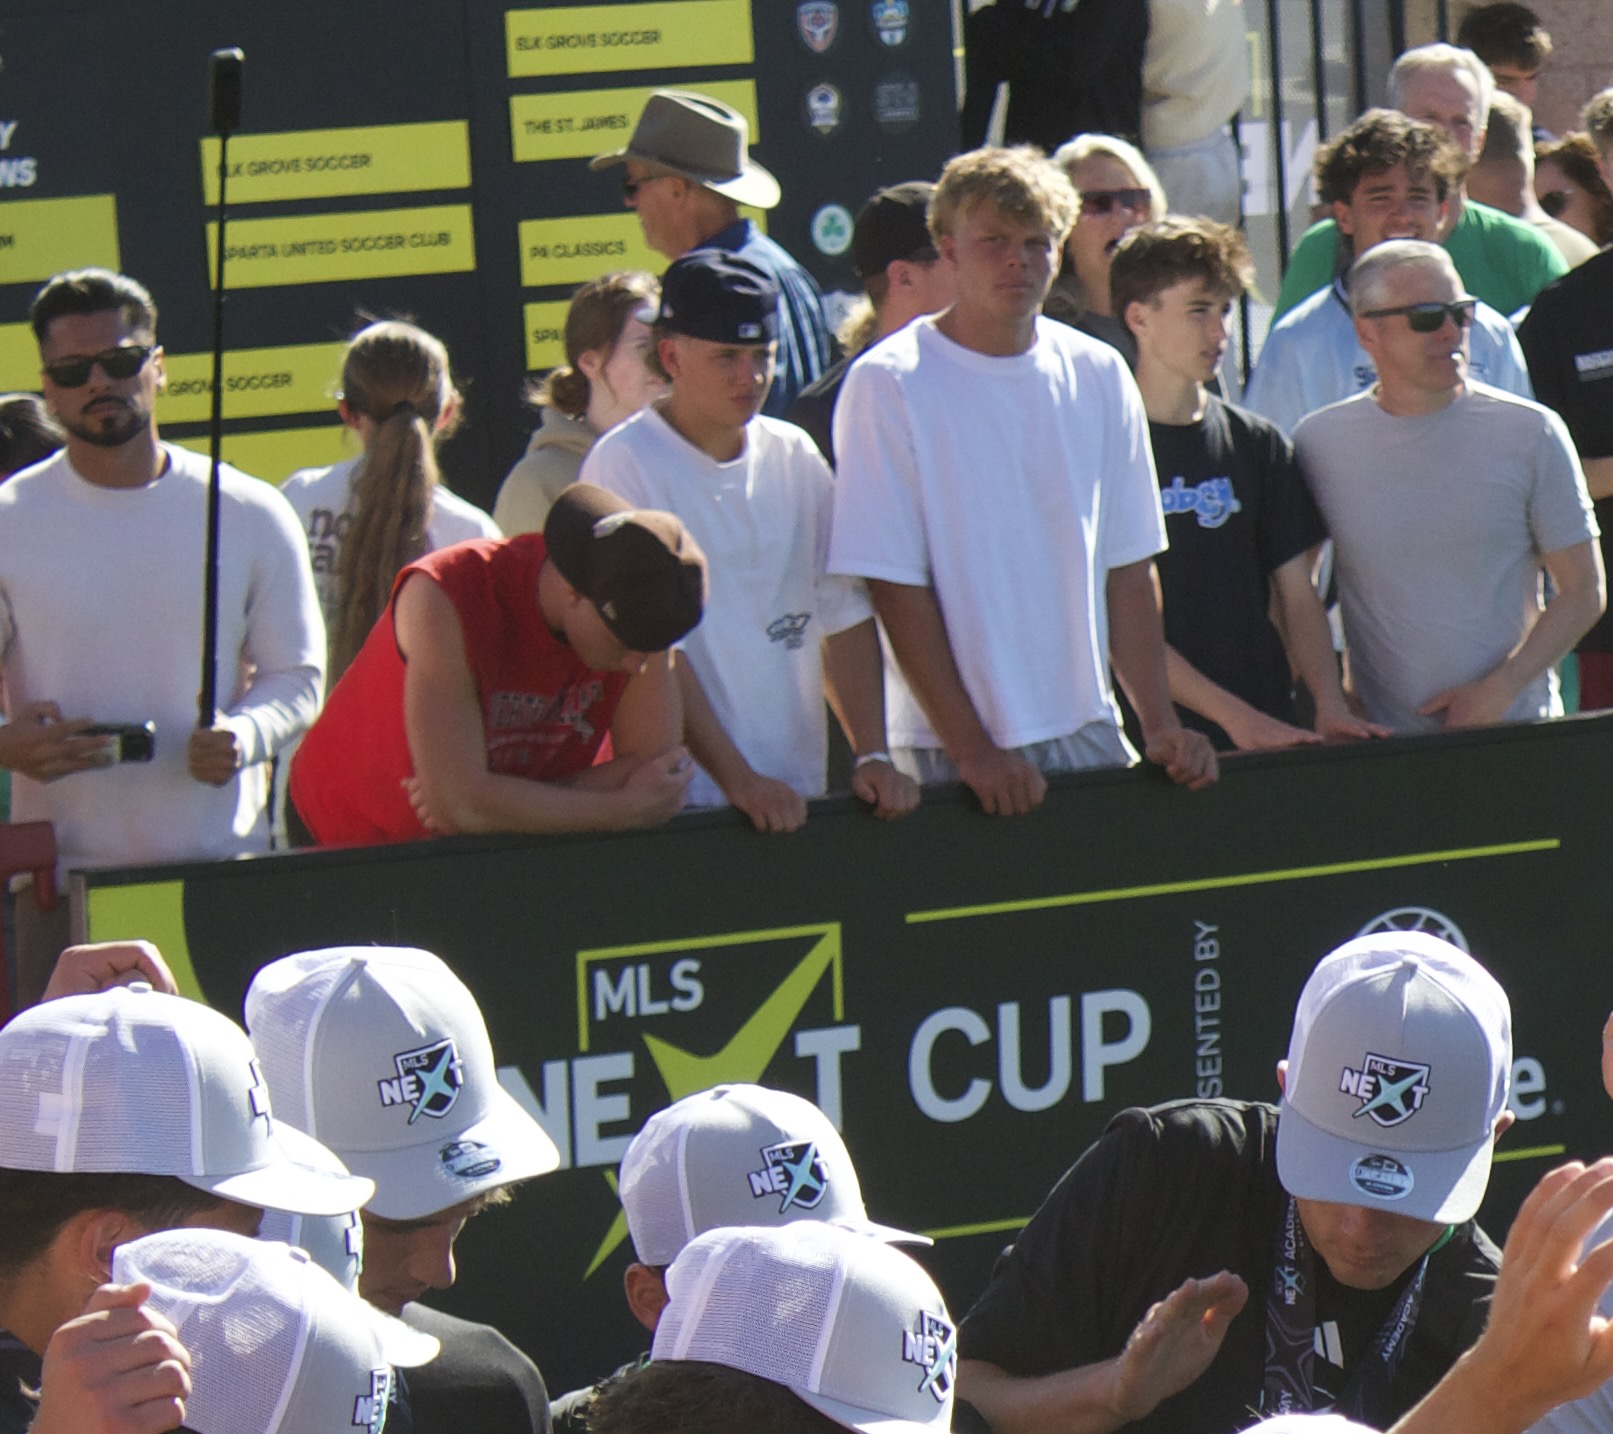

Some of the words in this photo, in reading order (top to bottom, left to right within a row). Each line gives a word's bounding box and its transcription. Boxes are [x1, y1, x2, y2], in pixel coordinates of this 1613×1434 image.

[516, 34, 541, 50] ELK
[547, 32, 597, 50] GROVE
[601, 30, 661, 47] SOCCER
[524, 118, 551, 134] THE
[579, 115, 629, 132] JAMES
[249, 158, 301, 177] GROVE
[306, 153, 371, 172] SOCCER
[283, 239, 336, 258] UNITED
[341, 235, 405, 255] SOCCER
[410, 231, 451, 249] CLUB
[530, 246, 548, 259] PA
[552, 240, 626, 260] CLASSICS
[532, 329, 560, 345] SPA
[168, 378, 218, 397] GROV
[226, 371, 293, 392] SOCCER
[1193, 920, 1220, 961] BY
[594, 957, 704, 1022] MLS
[1195, 967, 1223, 1100] SENTED
[907, 988, 1151, 1123] CUP
[1370, 1060, 1397, 1076] MLS
[1339, 1065, 1431, 1115] NEXT
